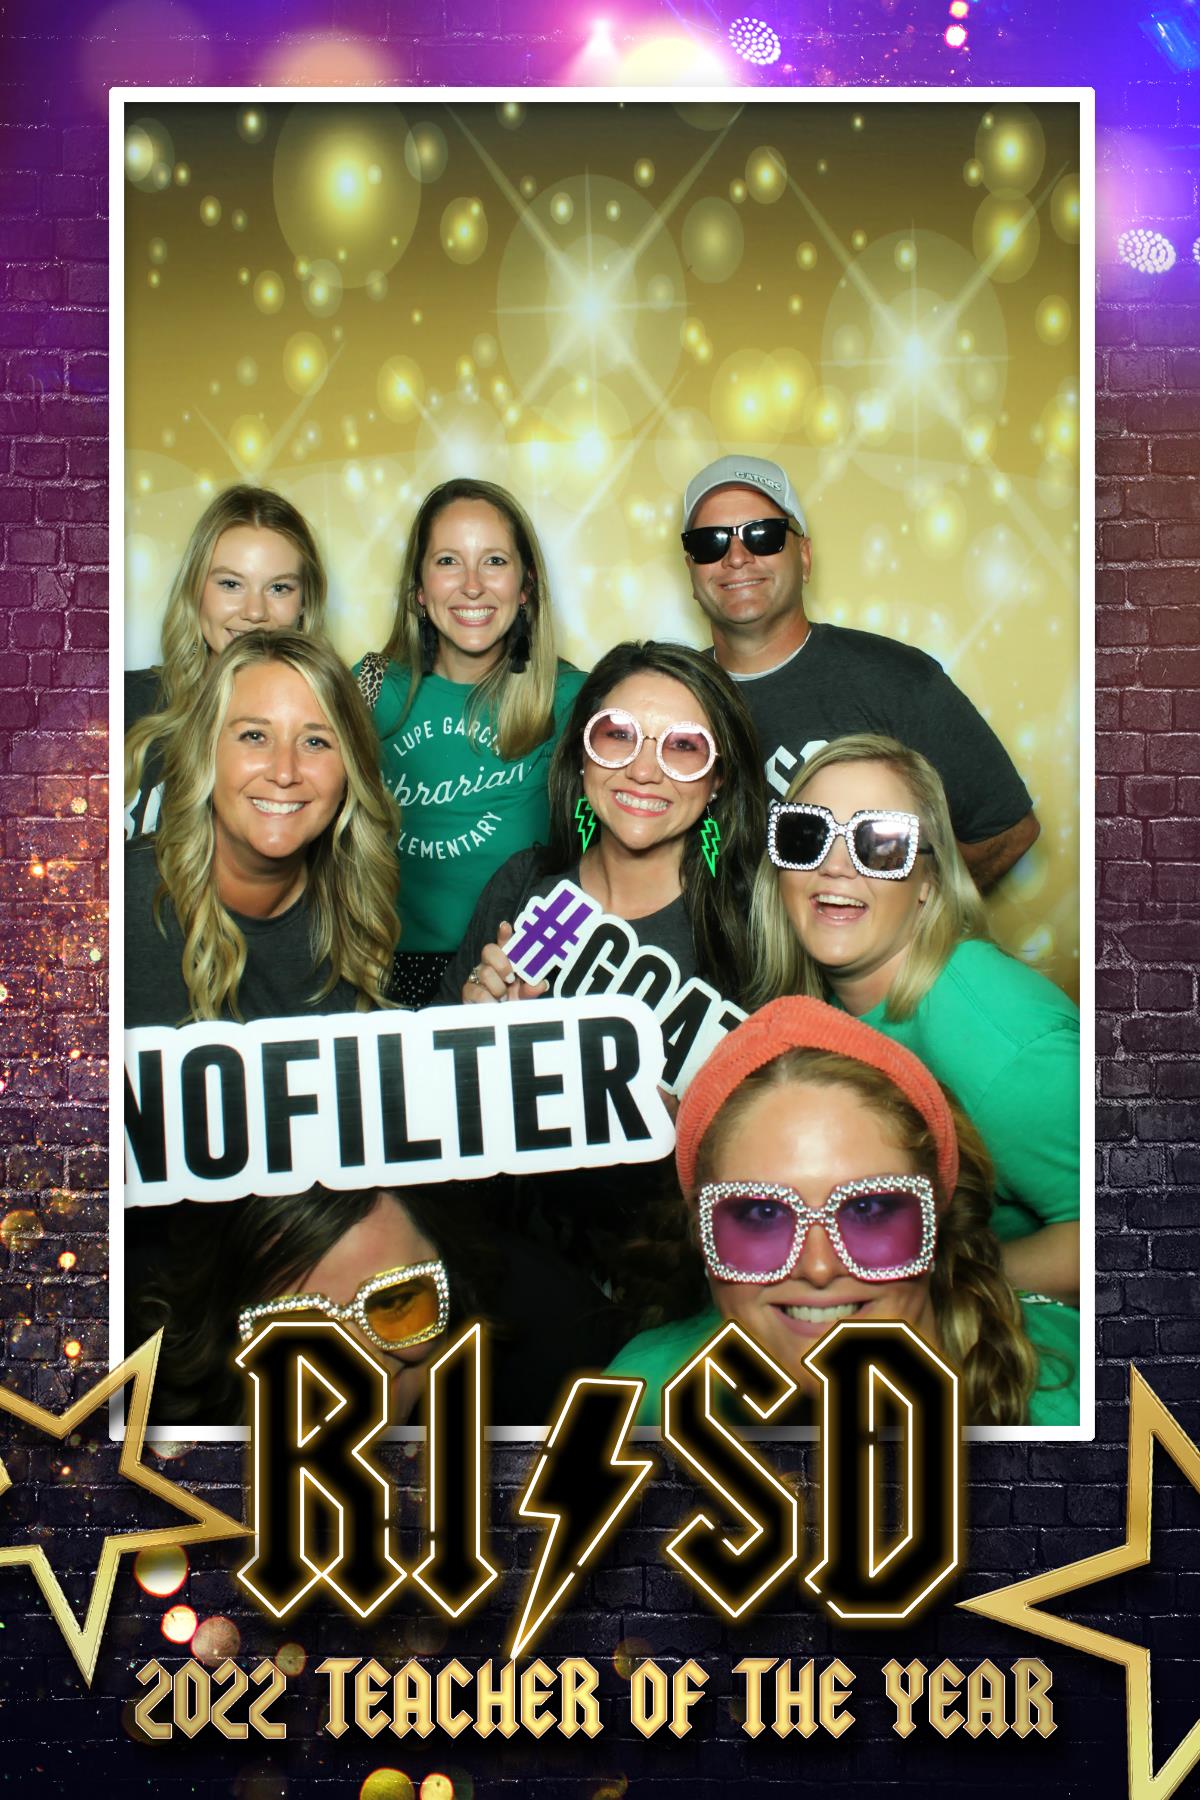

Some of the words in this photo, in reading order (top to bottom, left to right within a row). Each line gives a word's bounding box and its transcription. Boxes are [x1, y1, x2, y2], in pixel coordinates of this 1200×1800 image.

[735, 471, 782, 491] GATORS
[393, 720, 434, 757] LUPE
[443, 716, 501, 756] GARCI
[380, 762, 533, 807] brarian
[397, 811, 502, 860] LEMENTARY
[506, 888, 744, 1088] #GOA
[124, 1016, 653, 1185] NOFILTER
